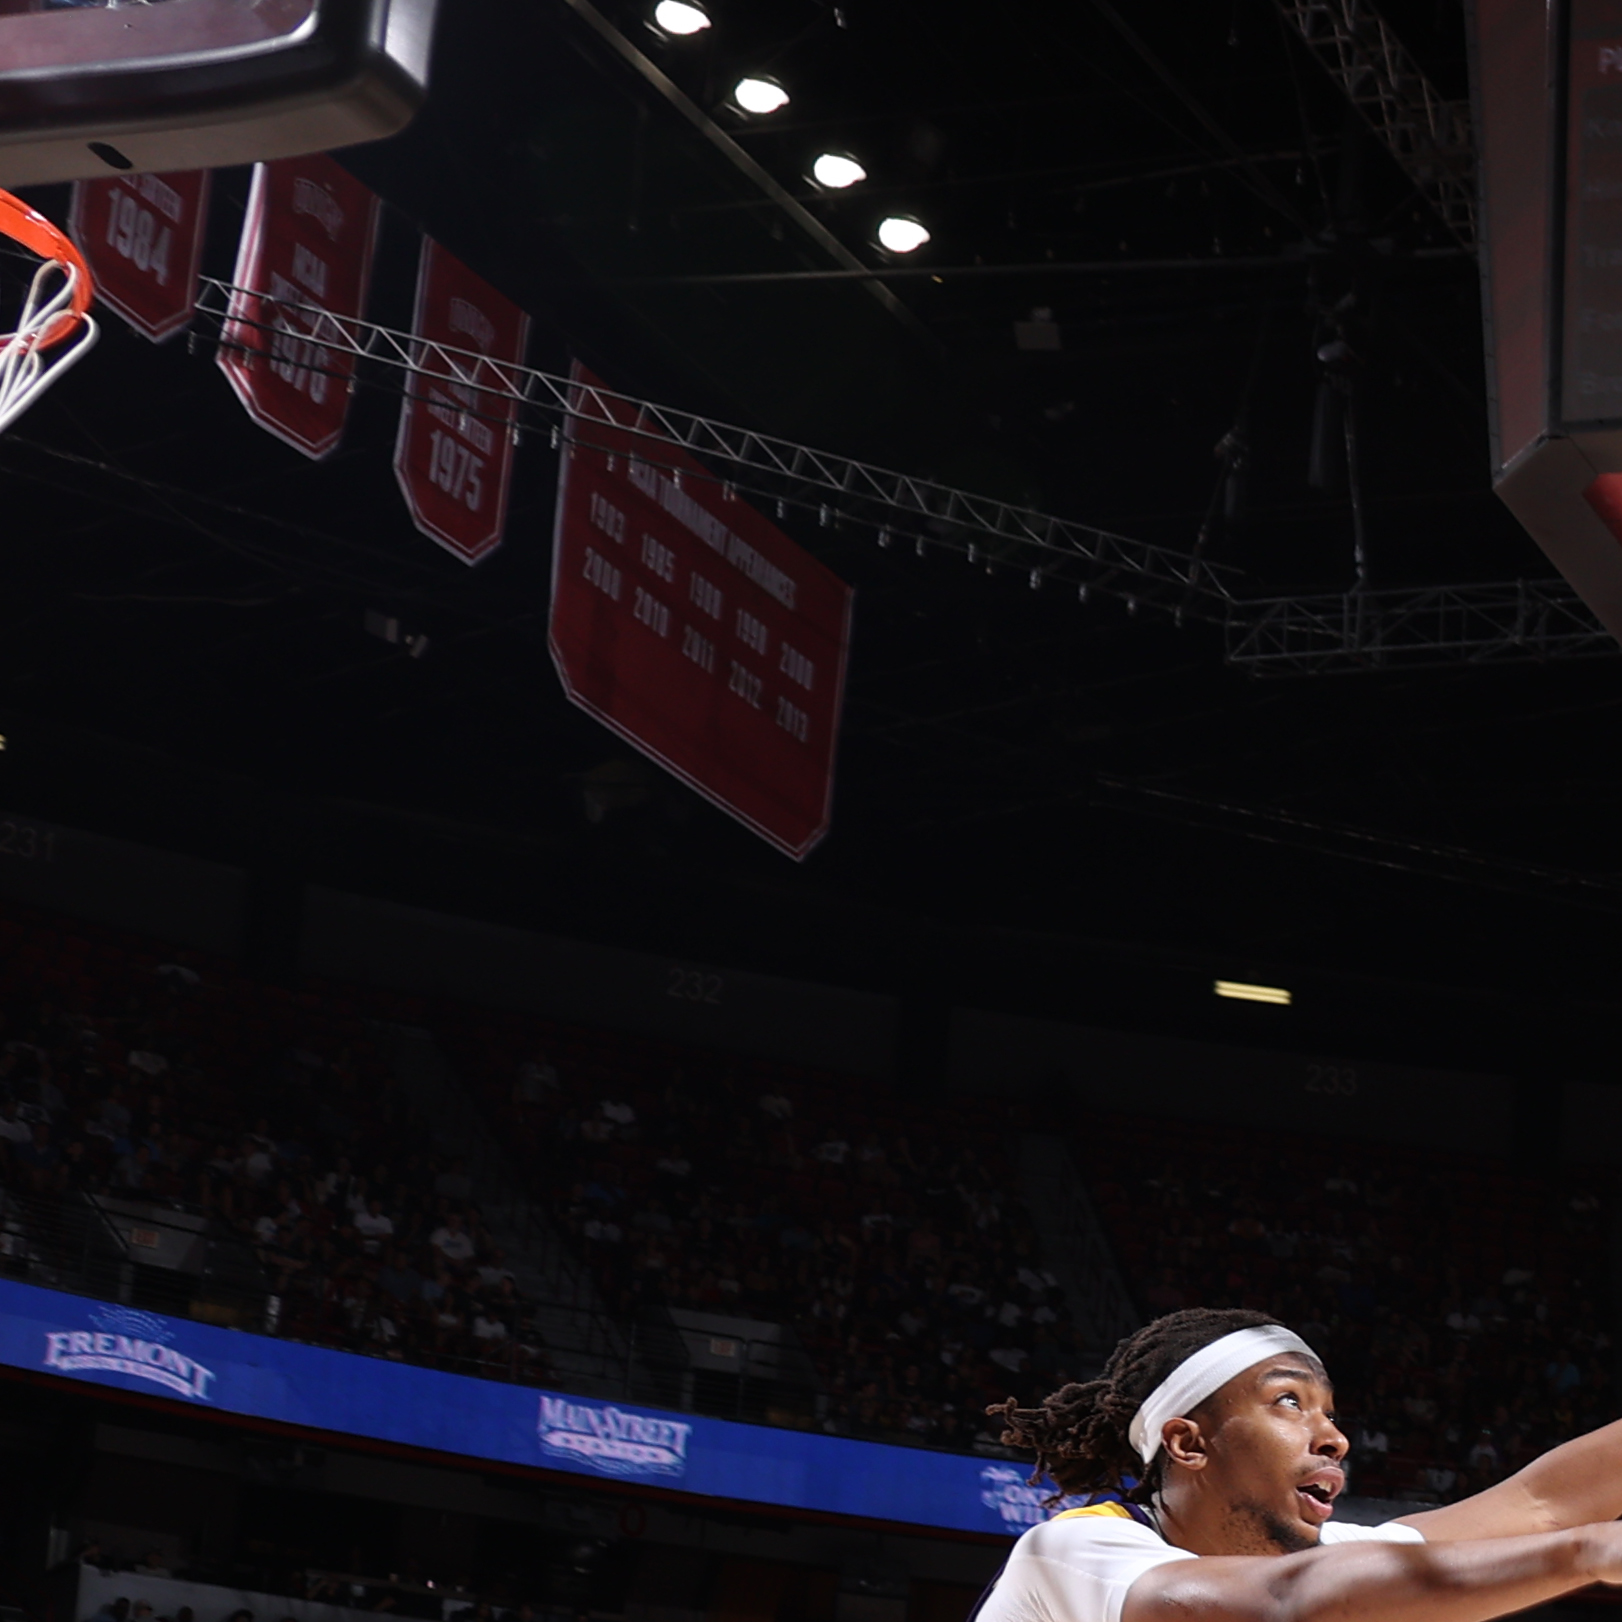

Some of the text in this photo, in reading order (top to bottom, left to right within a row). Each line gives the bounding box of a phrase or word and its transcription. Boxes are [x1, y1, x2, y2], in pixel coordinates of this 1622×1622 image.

[106, 186, 173, 287] 1984
[428, 428, 487, 513] 1975
[666, 967, 724, 1006] 232
[1304, 1064, 1358, 1097] 233
[44, 1331, 217, 1402] FREMONT
